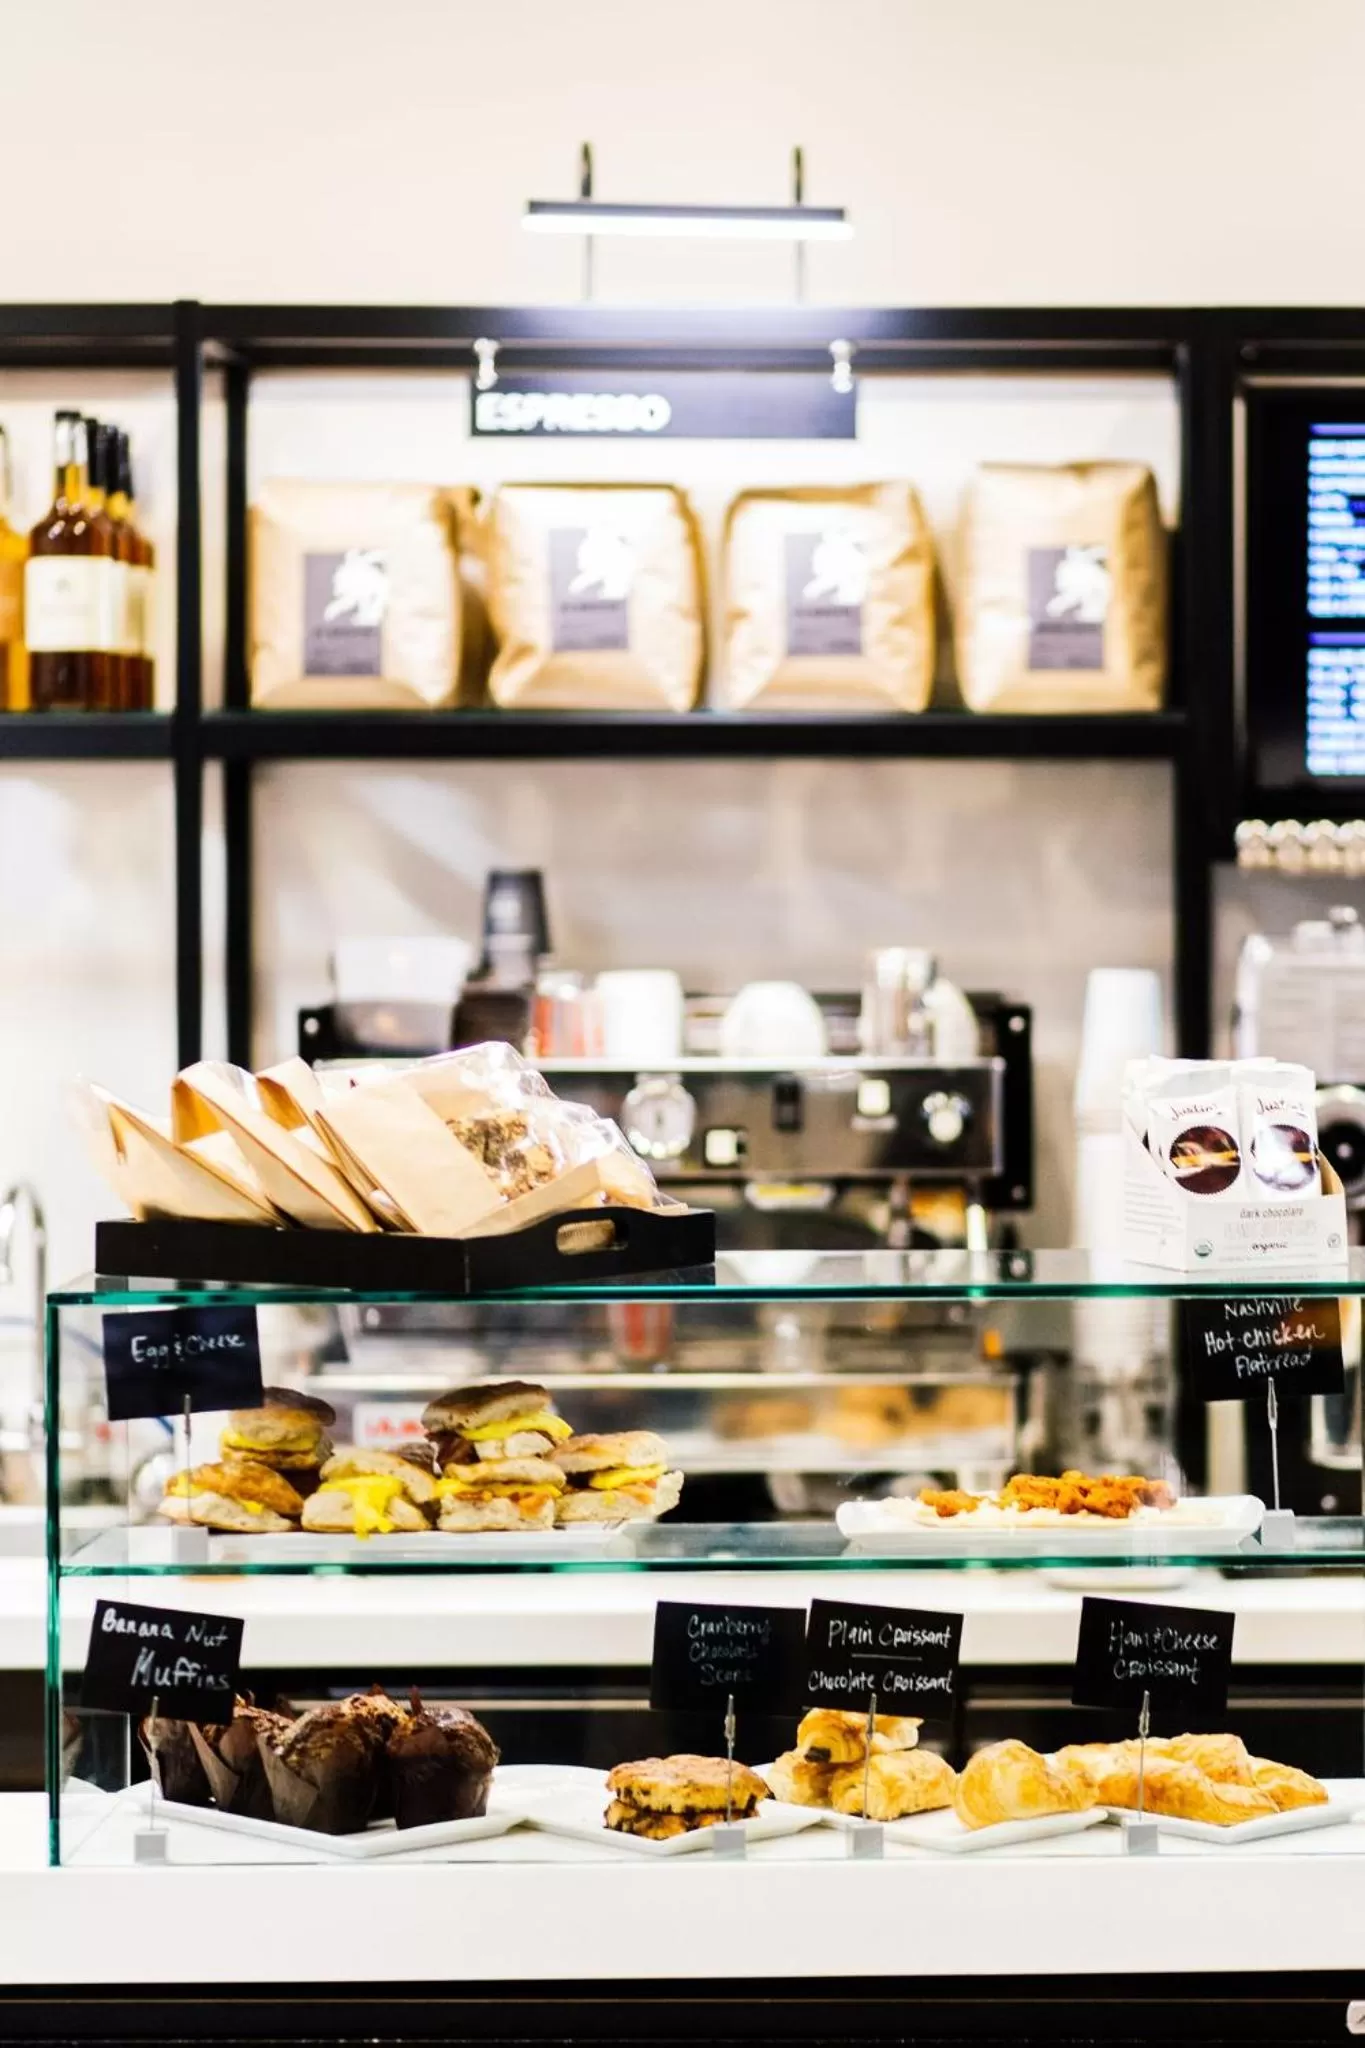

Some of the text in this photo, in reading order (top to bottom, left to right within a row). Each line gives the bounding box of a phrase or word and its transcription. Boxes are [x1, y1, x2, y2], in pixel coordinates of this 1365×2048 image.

[475, 392, 672, 432] ESPRESSO
[1240, 1209, 1260, 1219] dark
[1224, 1296, 1304, 1320] Nashville
[131, 1335, 169, 1369] Egg
[101, 1607, 229, 1647] Banana Nut
[687, 1613, 772, 1645] Cranberry
[827, 1619, 873, 1648] Plain
[1108, 1619, 1149, 1656] Ham
[1161, 1627, 1219, 1653] Cheese
[130, 1647, 231, 1690] Muffins
[807, 1667, 876, 1692] Chocolate
